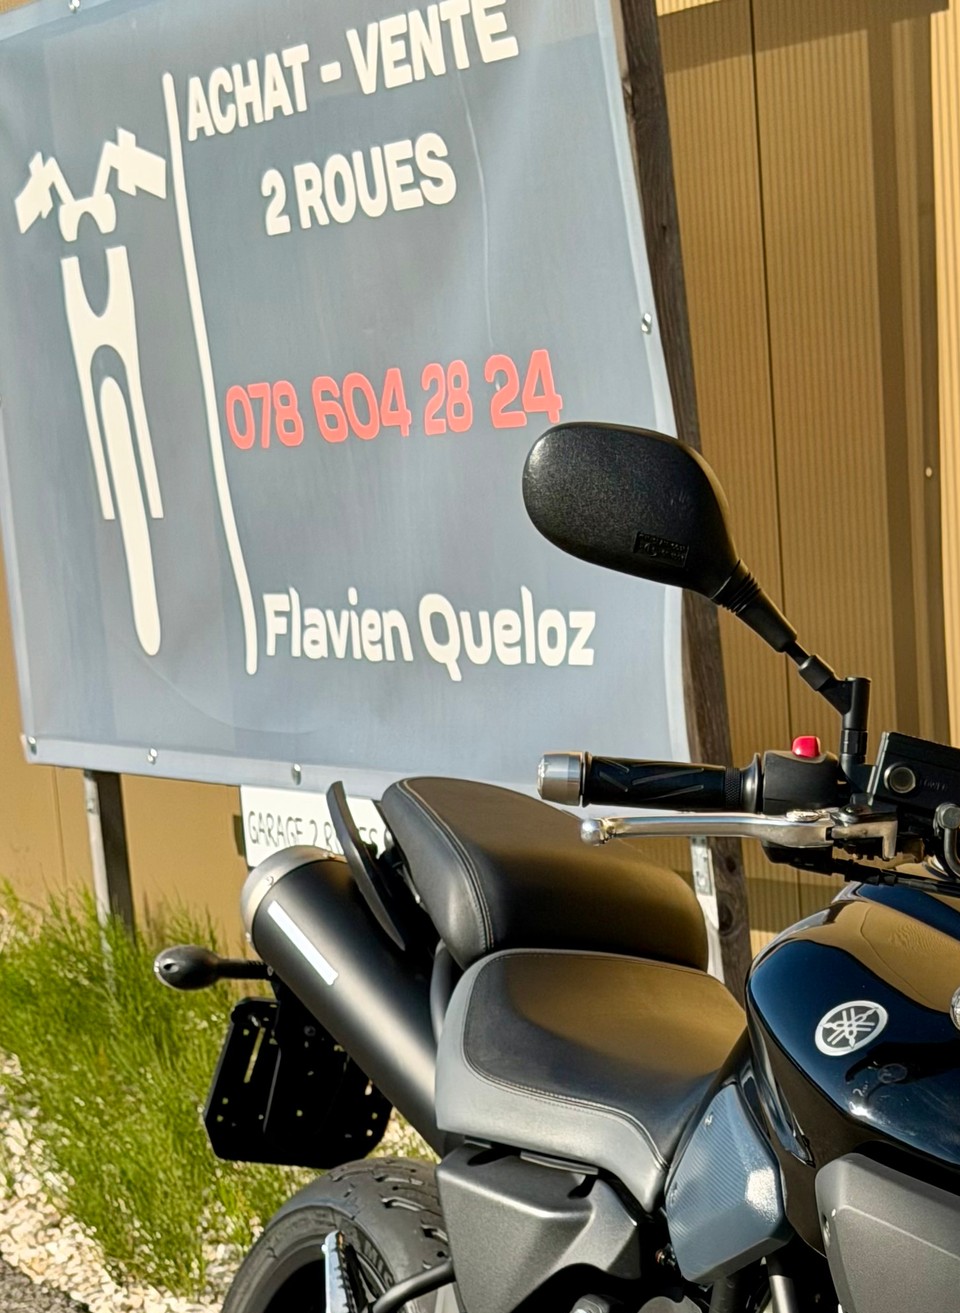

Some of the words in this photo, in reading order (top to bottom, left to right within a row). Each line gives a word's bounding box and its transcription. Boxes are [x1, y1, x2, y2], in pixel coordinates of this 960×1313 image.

[187, 43, 310, 142] ACHAT
[346, 0, 519, 95] VENTE
[261, 168, 291, 236] 2
[293, 132, 457, 229] ROUES
[226, 380, 304, 450] 078
[312, 367, 412, 443] 604
[421, 359, 473, 436] 28
[484, 349, 563, 429] 24
[263, 586, 414, 662] Flavien
[419, 584, 596, 682] Queloz
[248, 810, 303, 848] GARAGE
